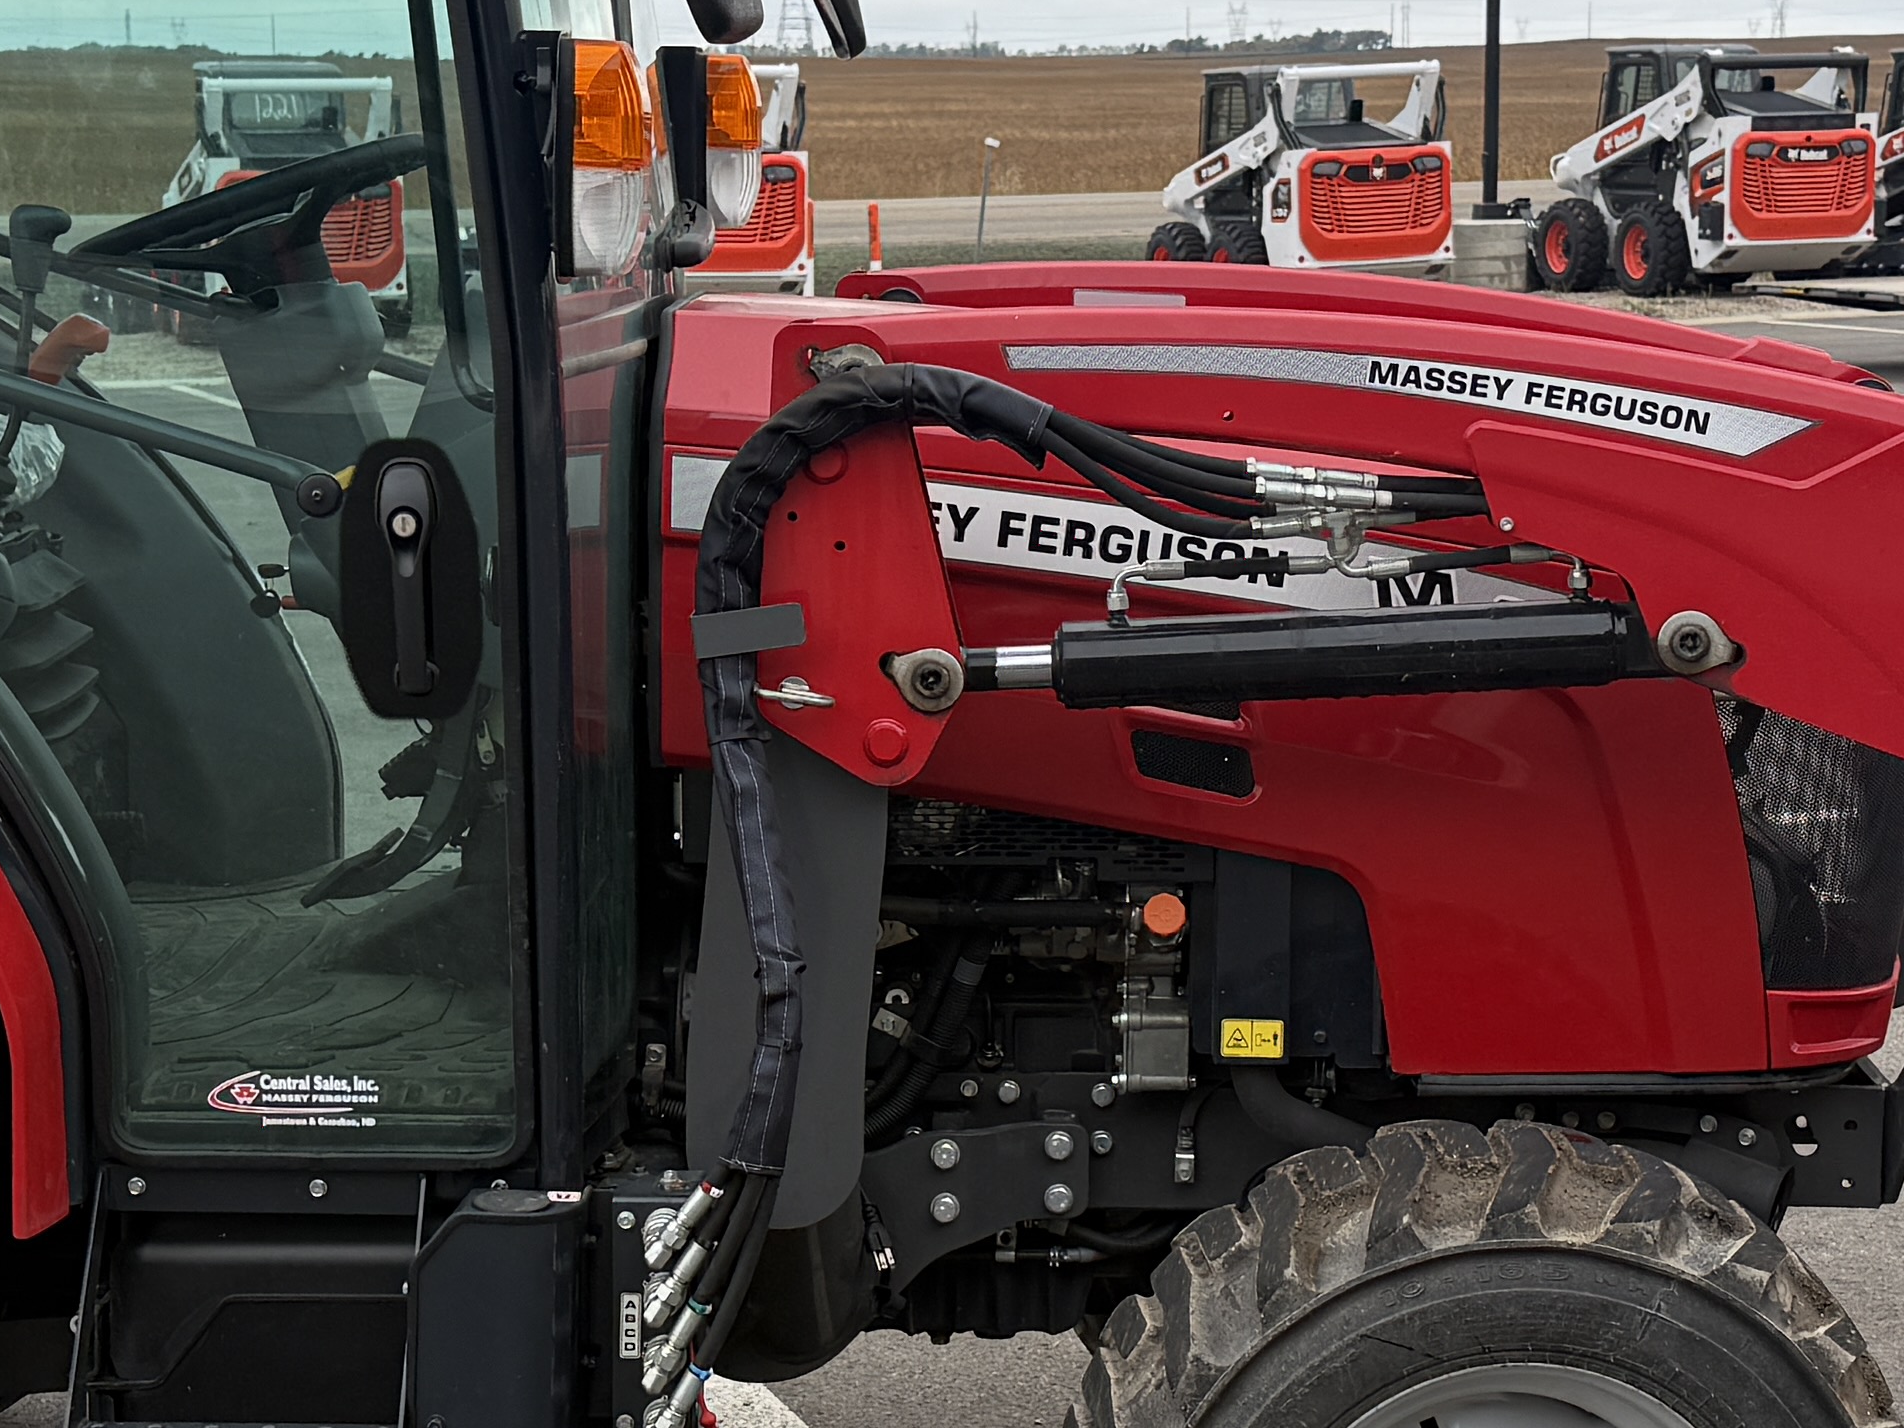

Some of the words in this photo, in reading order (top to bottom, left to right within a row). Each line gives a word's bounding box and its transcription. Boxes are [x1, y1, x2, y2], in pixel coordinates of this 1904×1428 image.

[1368, 360, 1514, 401] MASSEY
[1524, 381, 1711, 435] FERGUSON
[259, 1074, 311, 1091] Central
[313, 1075, 352, 1093] Sales,
[353, 1075, 380, 1091] Inc.
[262, 1093, 310, 1103] MASSEY
[311, 1094, 379, 1103] FERGUSON
[625, 1300, 636, 1309] A
[625, 1329, 635, 1337] C
[625, 1342, 635, 1351] D
